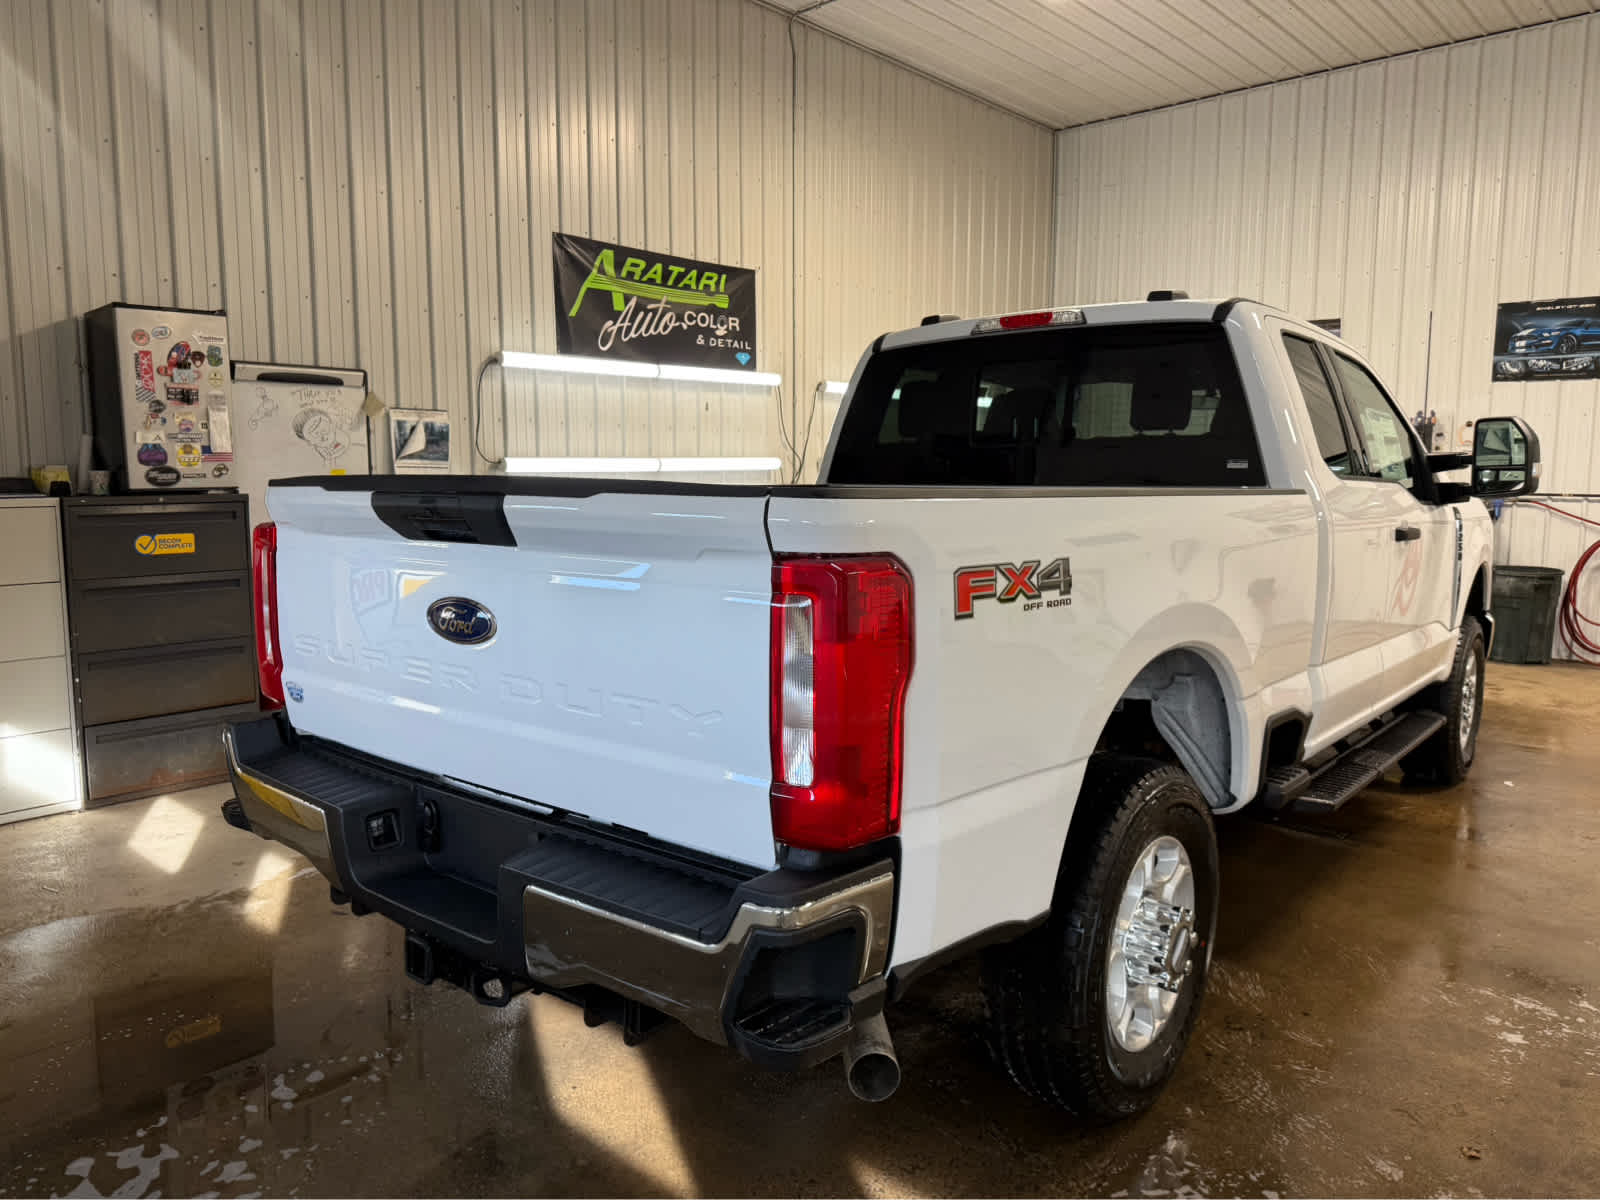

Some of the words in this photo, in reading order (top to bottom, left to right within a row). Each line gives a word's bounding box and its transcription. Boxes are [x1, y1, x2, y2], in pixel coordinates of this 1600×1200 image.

[568, 249, 729, 317] ARATARI
[598, 295, 682, 351] Auto
[683, 311, 740, 332] COLOR
[696, 335, 705, 345] &
[709, 338, 752, 350] DETAIL
[953, 557, 1072, 621] FX4
[1023, 601, 1044, 612] OFF
[1046, 598, 1072, 609] ROAD
[439, 606, 476, 635] Ford
[295, 633, 480, 694] SUPER
[499, 672, 724, 738] DUTY
